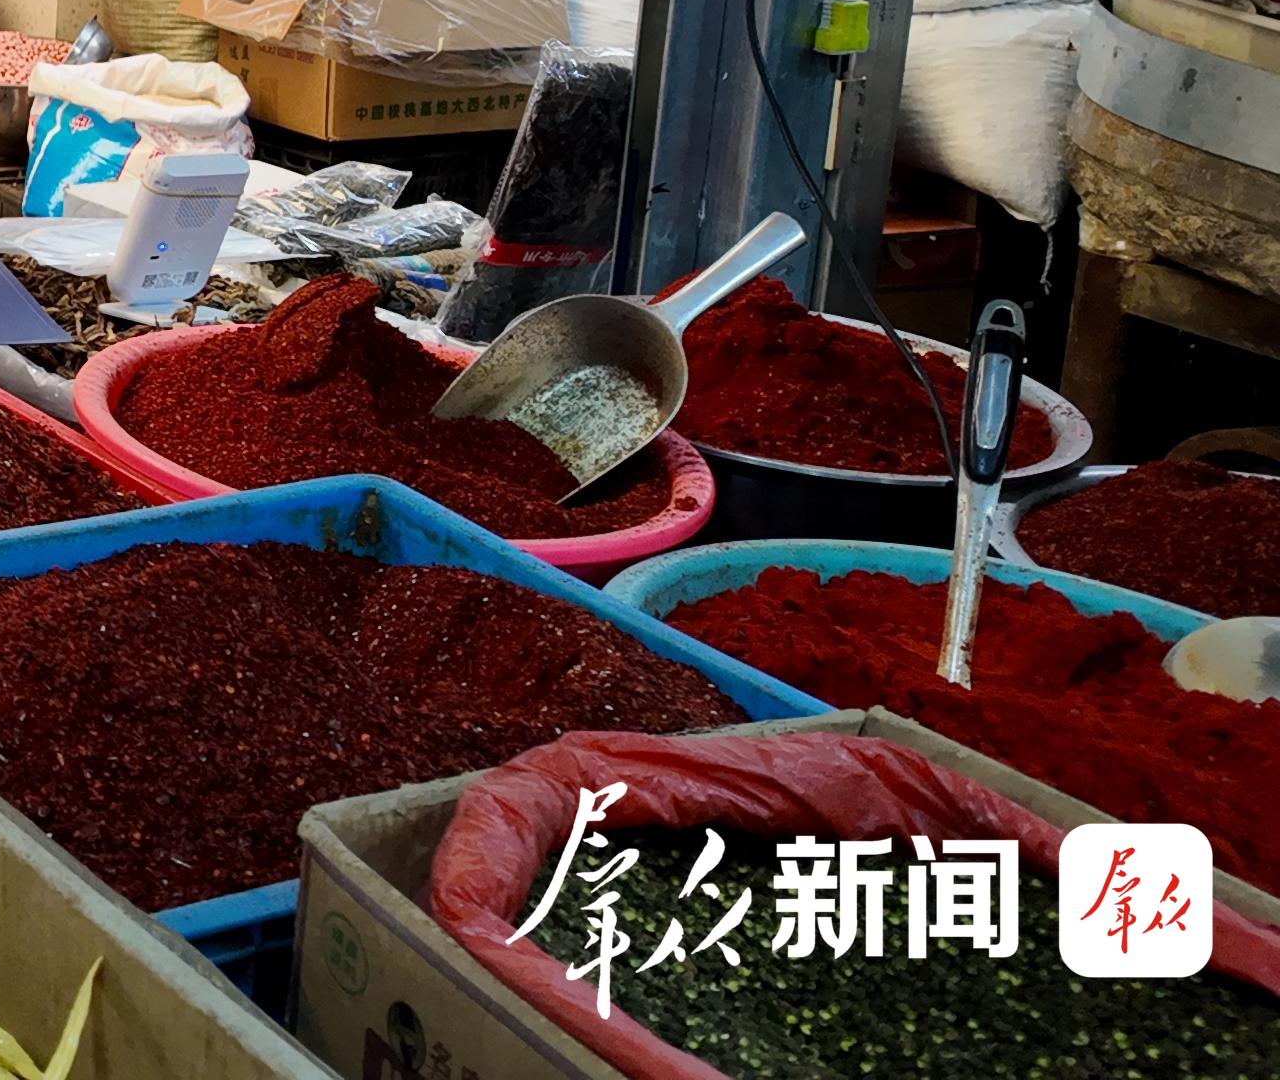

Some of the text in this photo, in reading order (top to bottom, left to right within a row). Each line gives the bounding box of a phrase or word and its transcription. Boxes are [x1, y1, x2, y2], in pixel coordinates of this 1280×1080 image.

[354, 92, 526, 122] 中国核桃基地大西北特产
